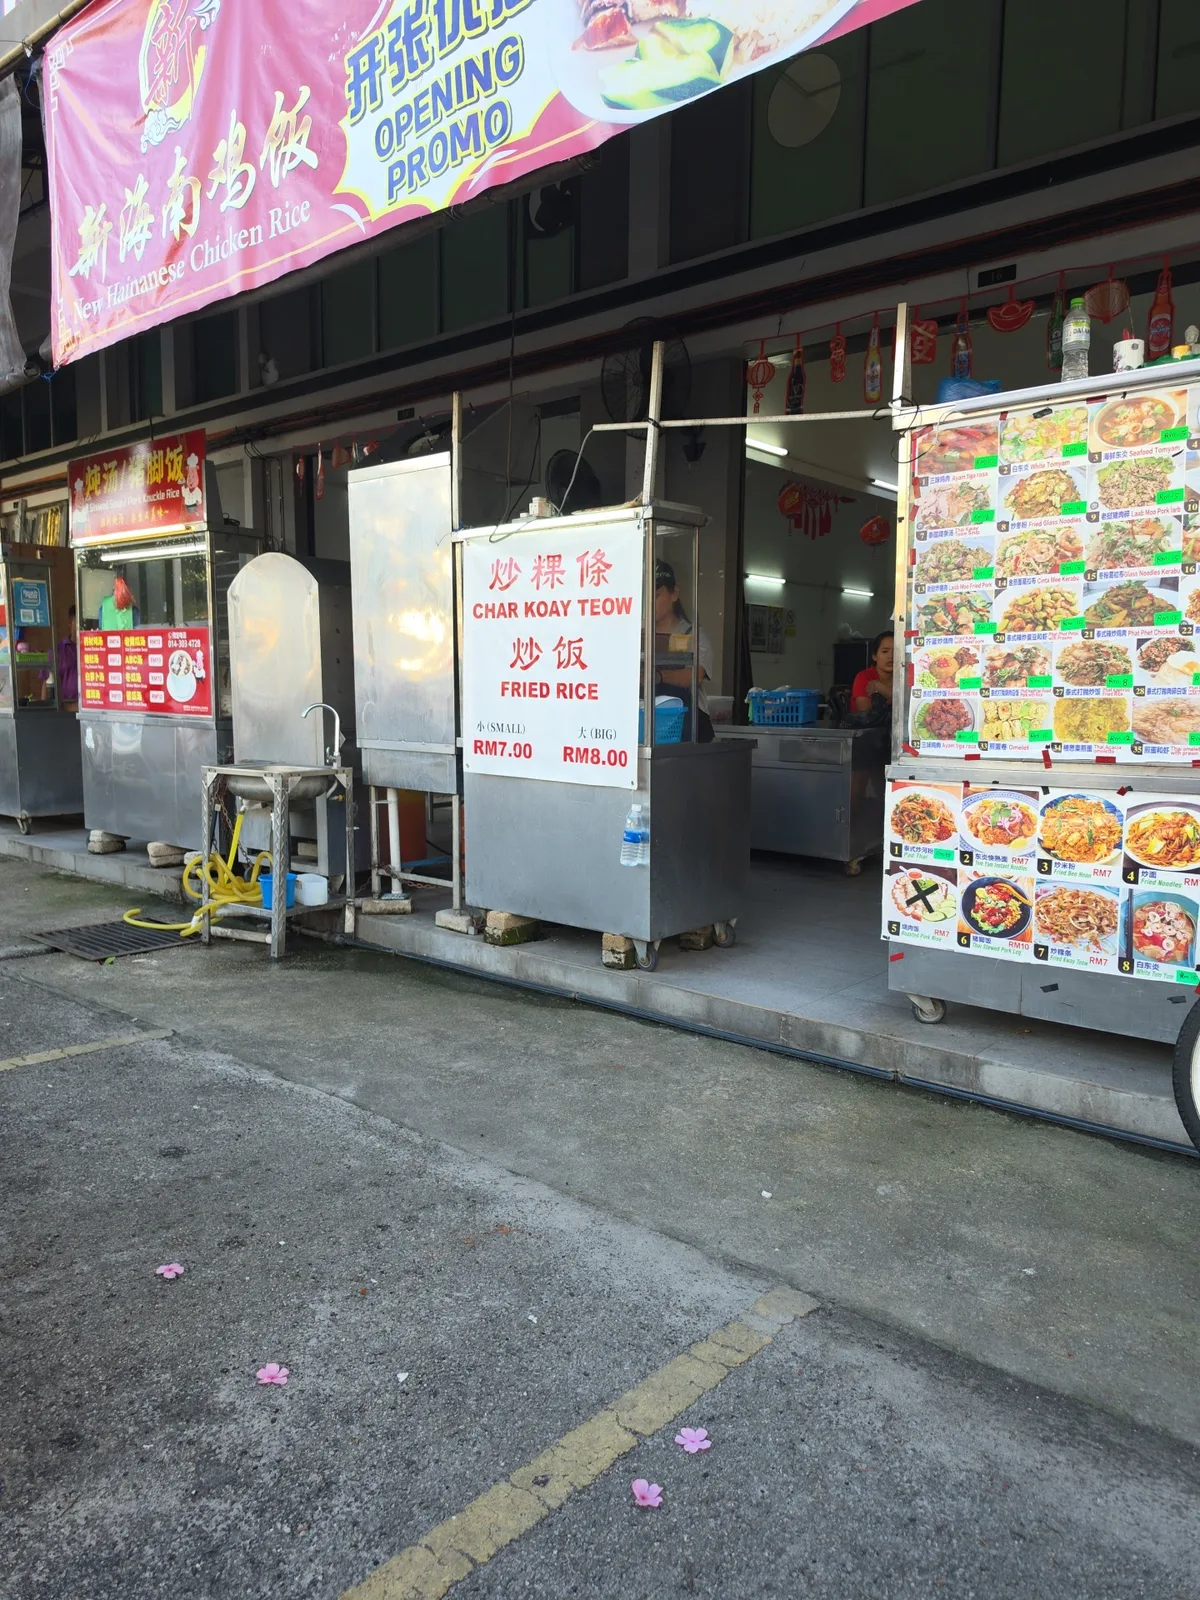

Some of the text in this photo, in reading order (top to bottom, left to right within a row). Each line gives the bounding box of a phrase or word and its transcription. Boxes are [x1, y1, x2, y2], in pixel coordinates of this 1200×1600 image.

[347, 0, 535, 120] 开张优
[375, 35, 521, 158] OPENING
[387, 101, 510, 200] PROMO
[69, 85, 320, 283] 新海南鸡饭
[74, 199, 311, 324] New Hainanese Chicken Rice
[1129, 448, 1153, 456] Seafood
[1154, 445, 1180, 453] Tomyam
[1030, 462, 1046, 470] White
[1047, 460, 1070, 468] Tomyam
[952, 474, 966, 482] Ayam
[128, 496, 142, 506] Pork
[143, 492, 165, 503] Knuckle
[166, 489, 180, 499] Rice
[1187, 503, 1198, 511] 10
[488, 548, 613, 592] 炒粿條
[1086, 572, 1096, 580] 15
[1124, 570, 1138, 578] Glass
[1184, 565, 1195, 573] 16
[997, 579, 1006, 587] 14
[472, 596, 633, 620] CHAR KOAY TEOW
[509, 635, 588, 672] 炒饭
[501, 681, 599, 701] FRIED RICE
[486, 721, 527, 736] (SMALL)
[577, 726, 618, 741] 大 (BIG)
[473, 739, 533, 760] RM7.00
[562, 746, 628, 768] RM8.00
[894, 846, 899, 855] 1
[963, 854, 970, 863] 2
[1011, 856, 1029, 865] RM7
[1041, 861, 1112, 878] 3 炒米粉 RM7
[1127, 871, 1135, 881] 4
[1141, 871, 1157, 879] 炒面
[1140, 878, 1183, 888] Fried Noodles
[891, 924, 897, 932] 5
[934, 929, 950, 937] RM7
[961, 936, 967, 945] 6
[1008, 941, 1030, 950] RM10
[982, 944, 1000, 952] Stewed
[1012, 948, 1022, 956] Leg
[1038, 948, 1044, 957] 7
[1089, 956, 1108, 966] RM7
[1063, 957, 1076, 965] Kway
[1122, 960, 1160, 971] 8 白东炎
[1136, 968, 1151, 976] White
